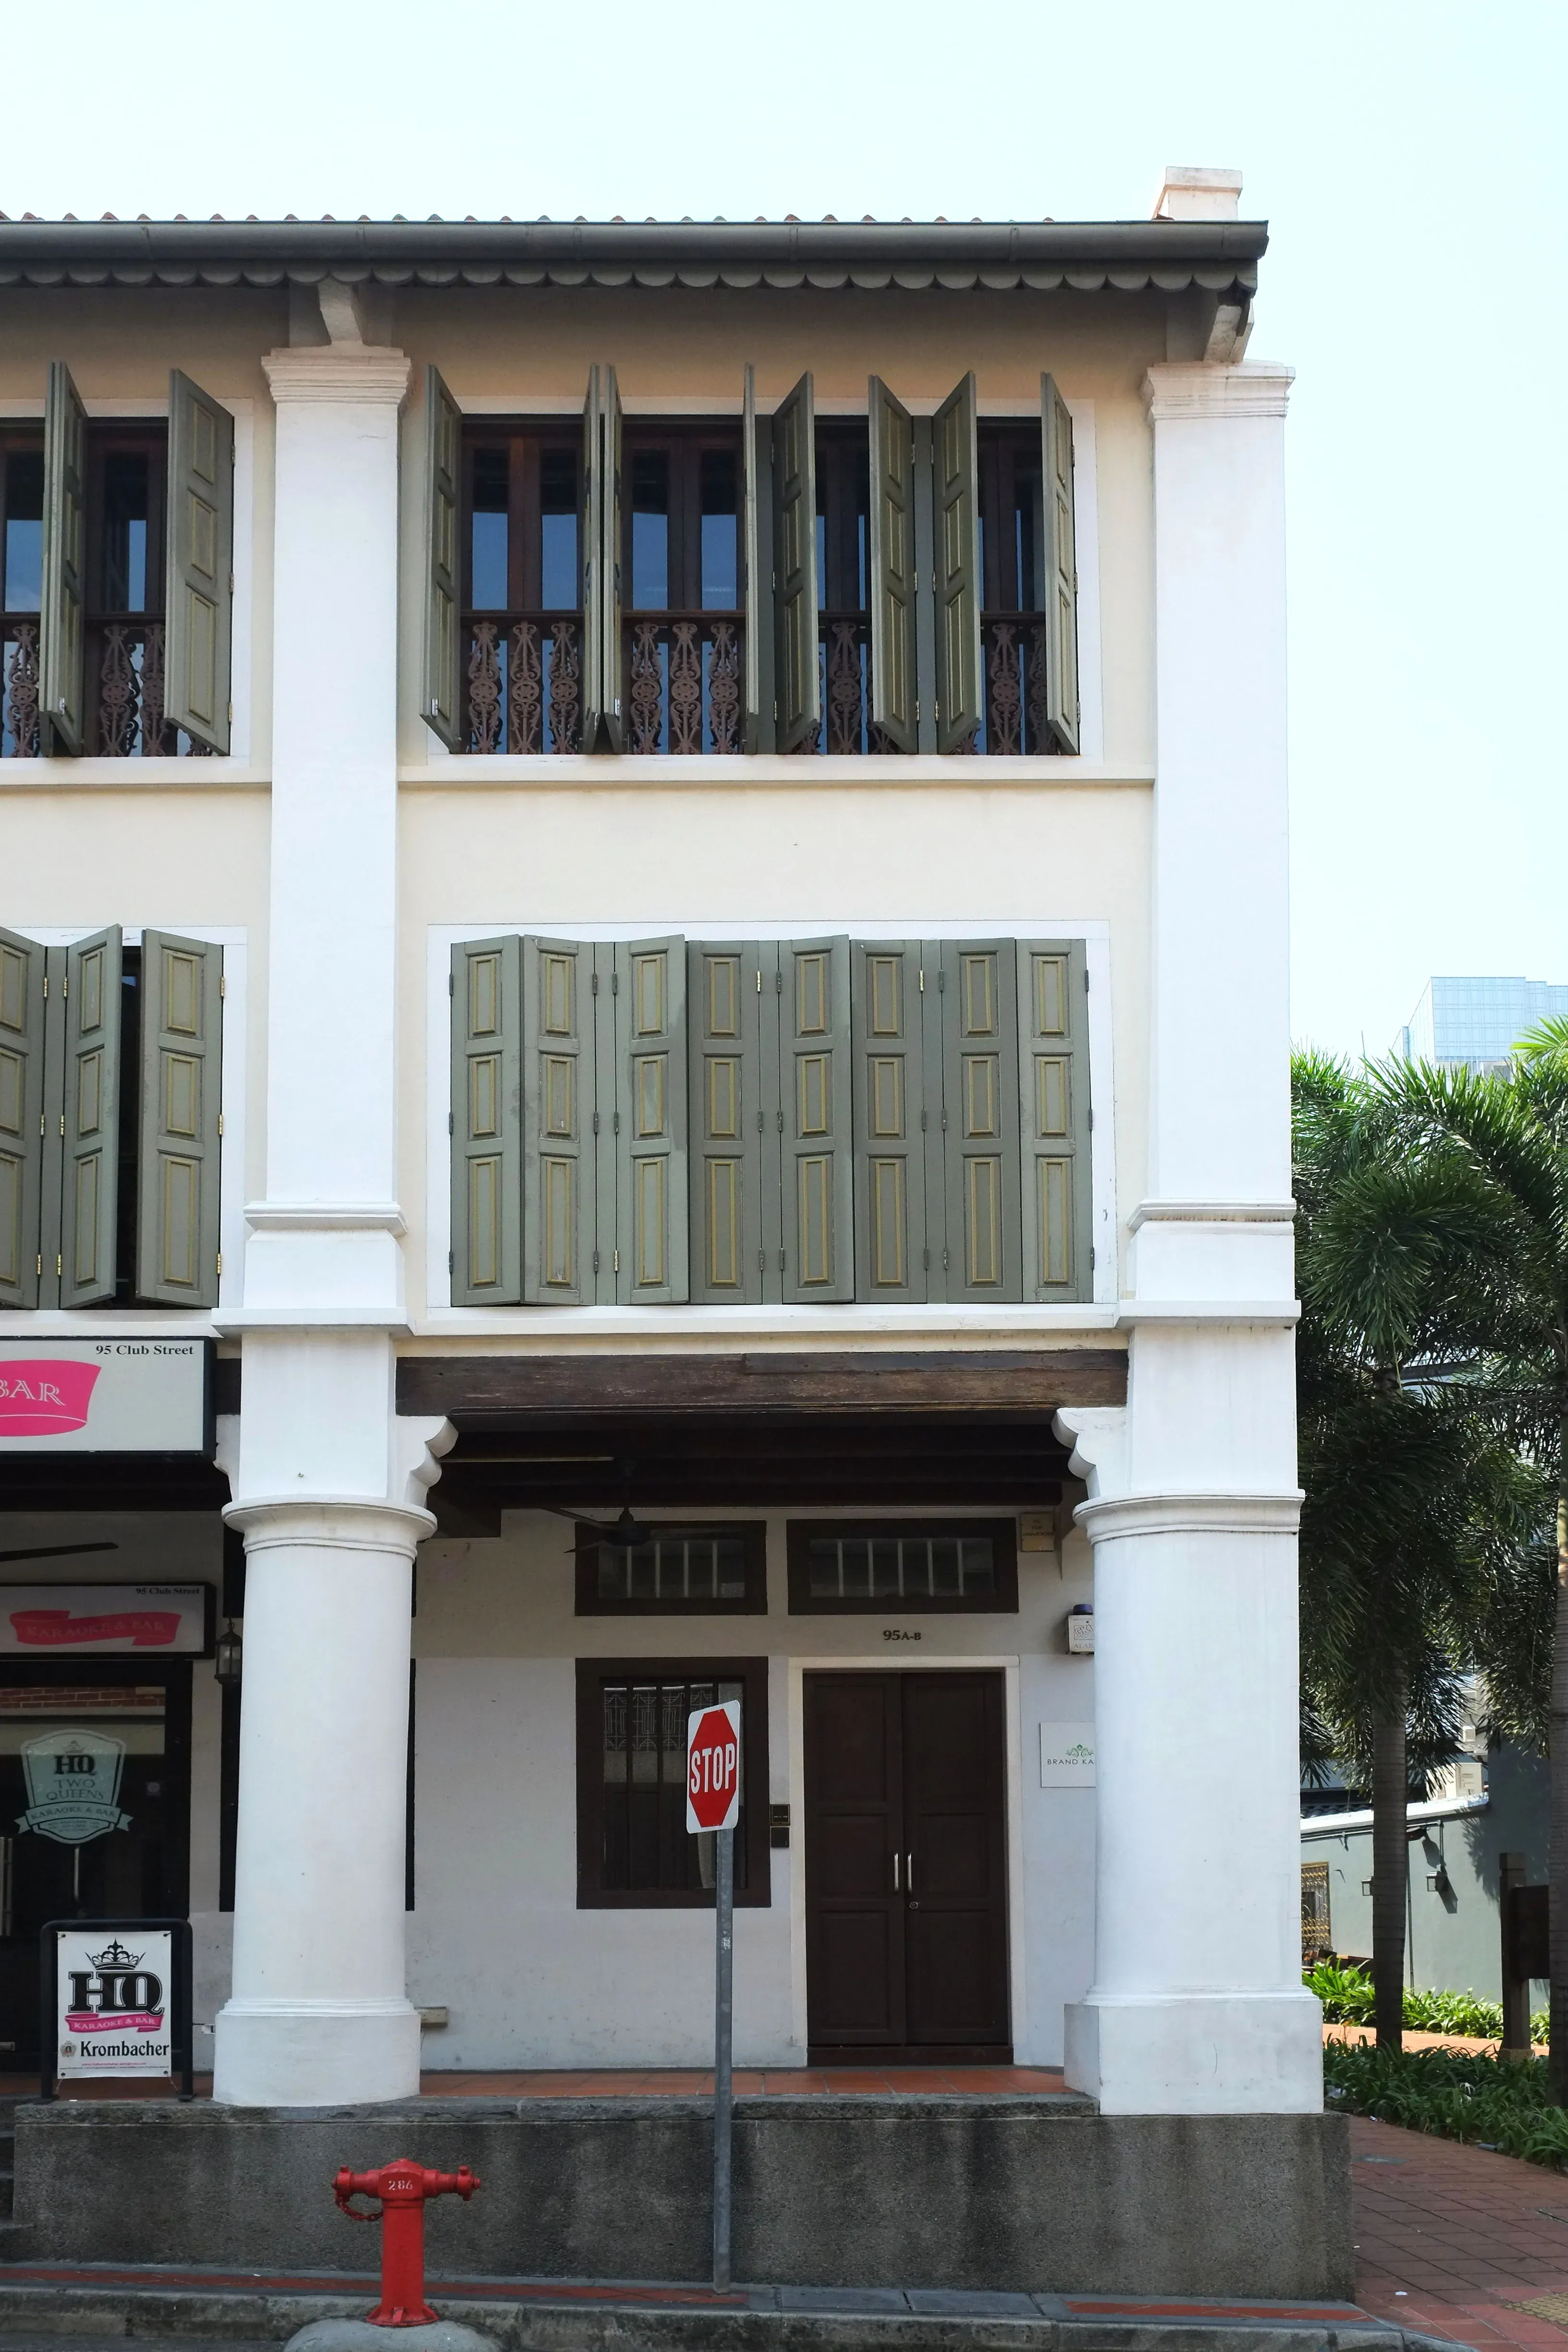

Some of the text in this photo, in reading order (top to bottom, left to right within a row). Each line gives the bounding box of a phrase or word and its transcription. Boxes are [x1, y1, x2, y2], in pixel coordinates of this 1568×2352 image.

[96, 1345, 194, 1355] 95 Club Street
[26, 1619, 165, 1638] KARAOKE & BAR
[883, 1629, 922, 1641] 95A-B
[54, 1755, 98, 1776] HQ
[691, 1743, 735, 1794] STOP
[54, 1779, 95, 1789] TWO
[31, 1806, 83, 1820] KARAOKE
[96, 1808, 117, 1818] BAR
[68, 1971, 165, 2017] HQ
[74, 2019, 123, 2029] KARAOKE
[81, 2040, 170, 2057] Krombacher
[388, 2180, 413, 2190] 286
